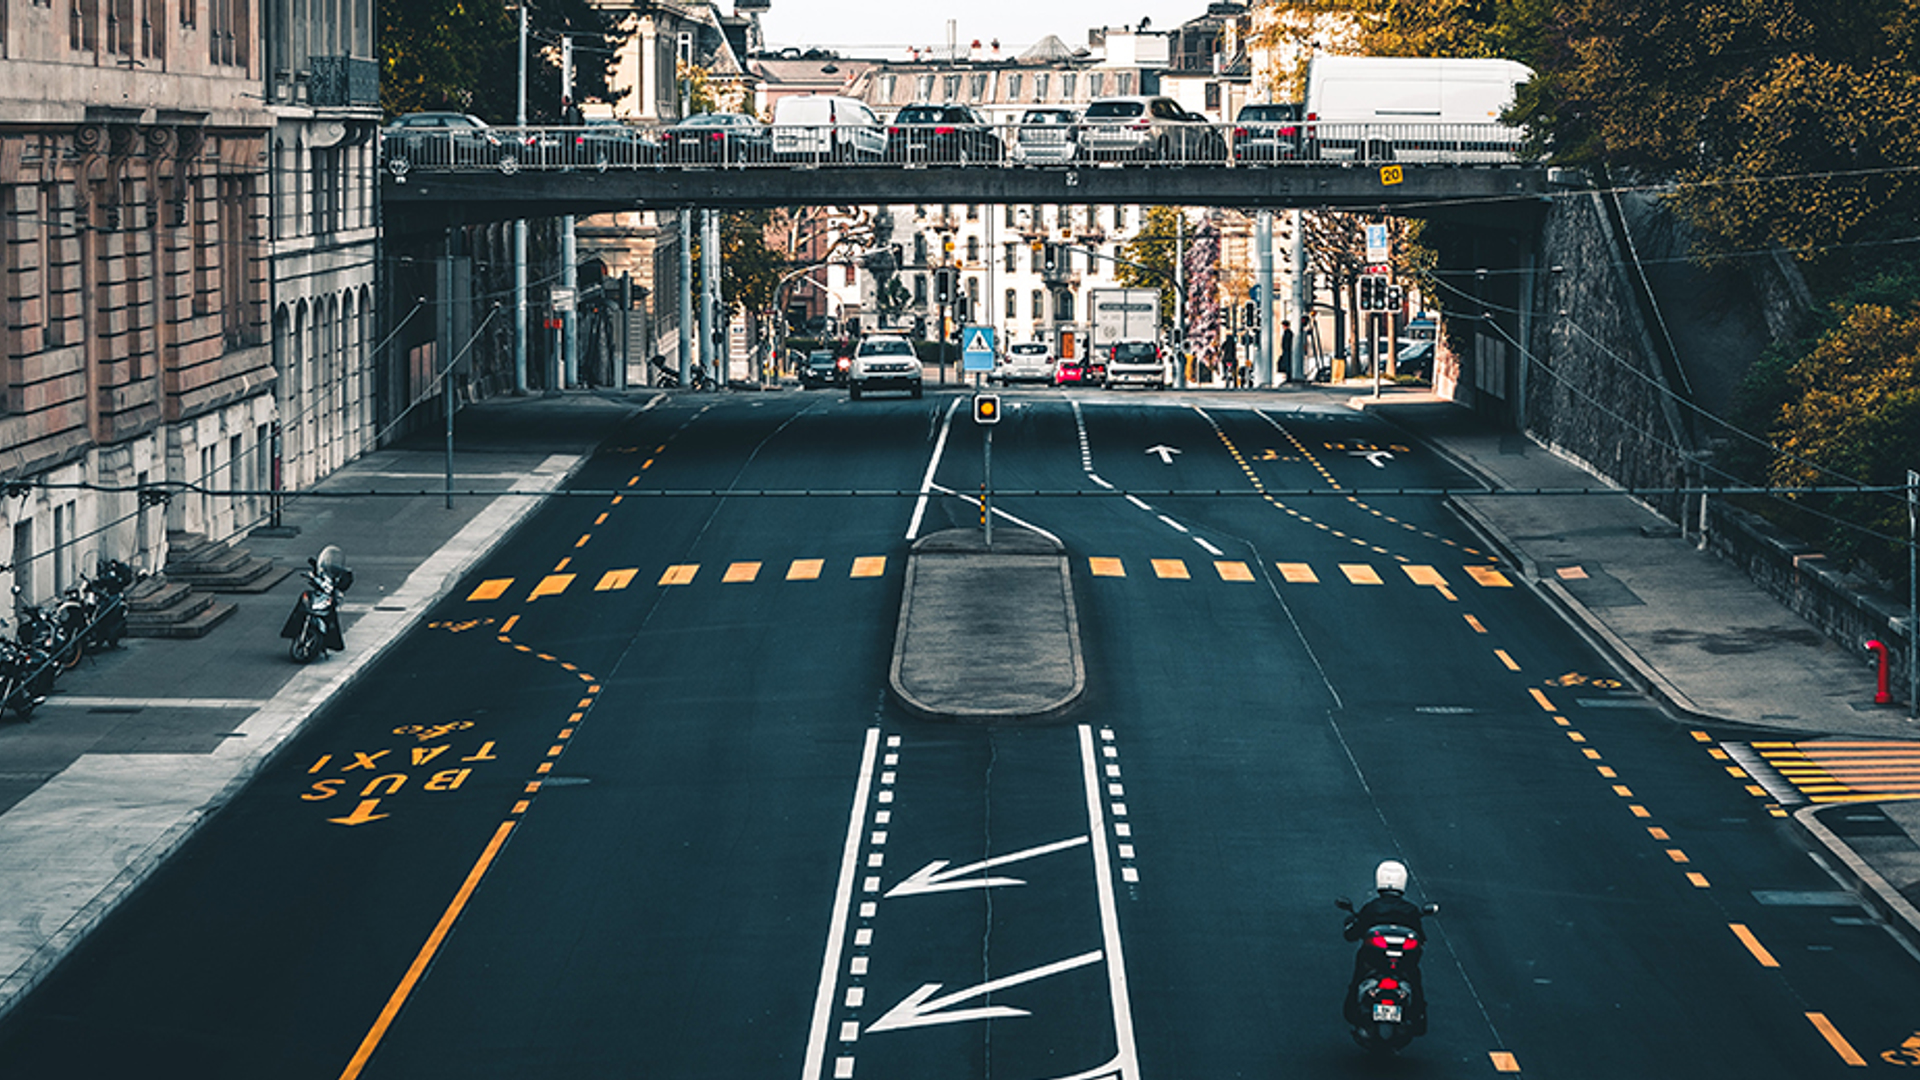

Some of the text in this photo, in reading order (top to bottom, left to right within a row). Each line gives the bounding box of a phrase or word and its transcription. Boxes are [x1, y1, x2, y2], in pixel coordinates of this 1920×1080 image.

[1384, 168, 1399, 181] 20
[308, 741, 496, 774] TAXI
[301, 768, 472, 800] BUS
